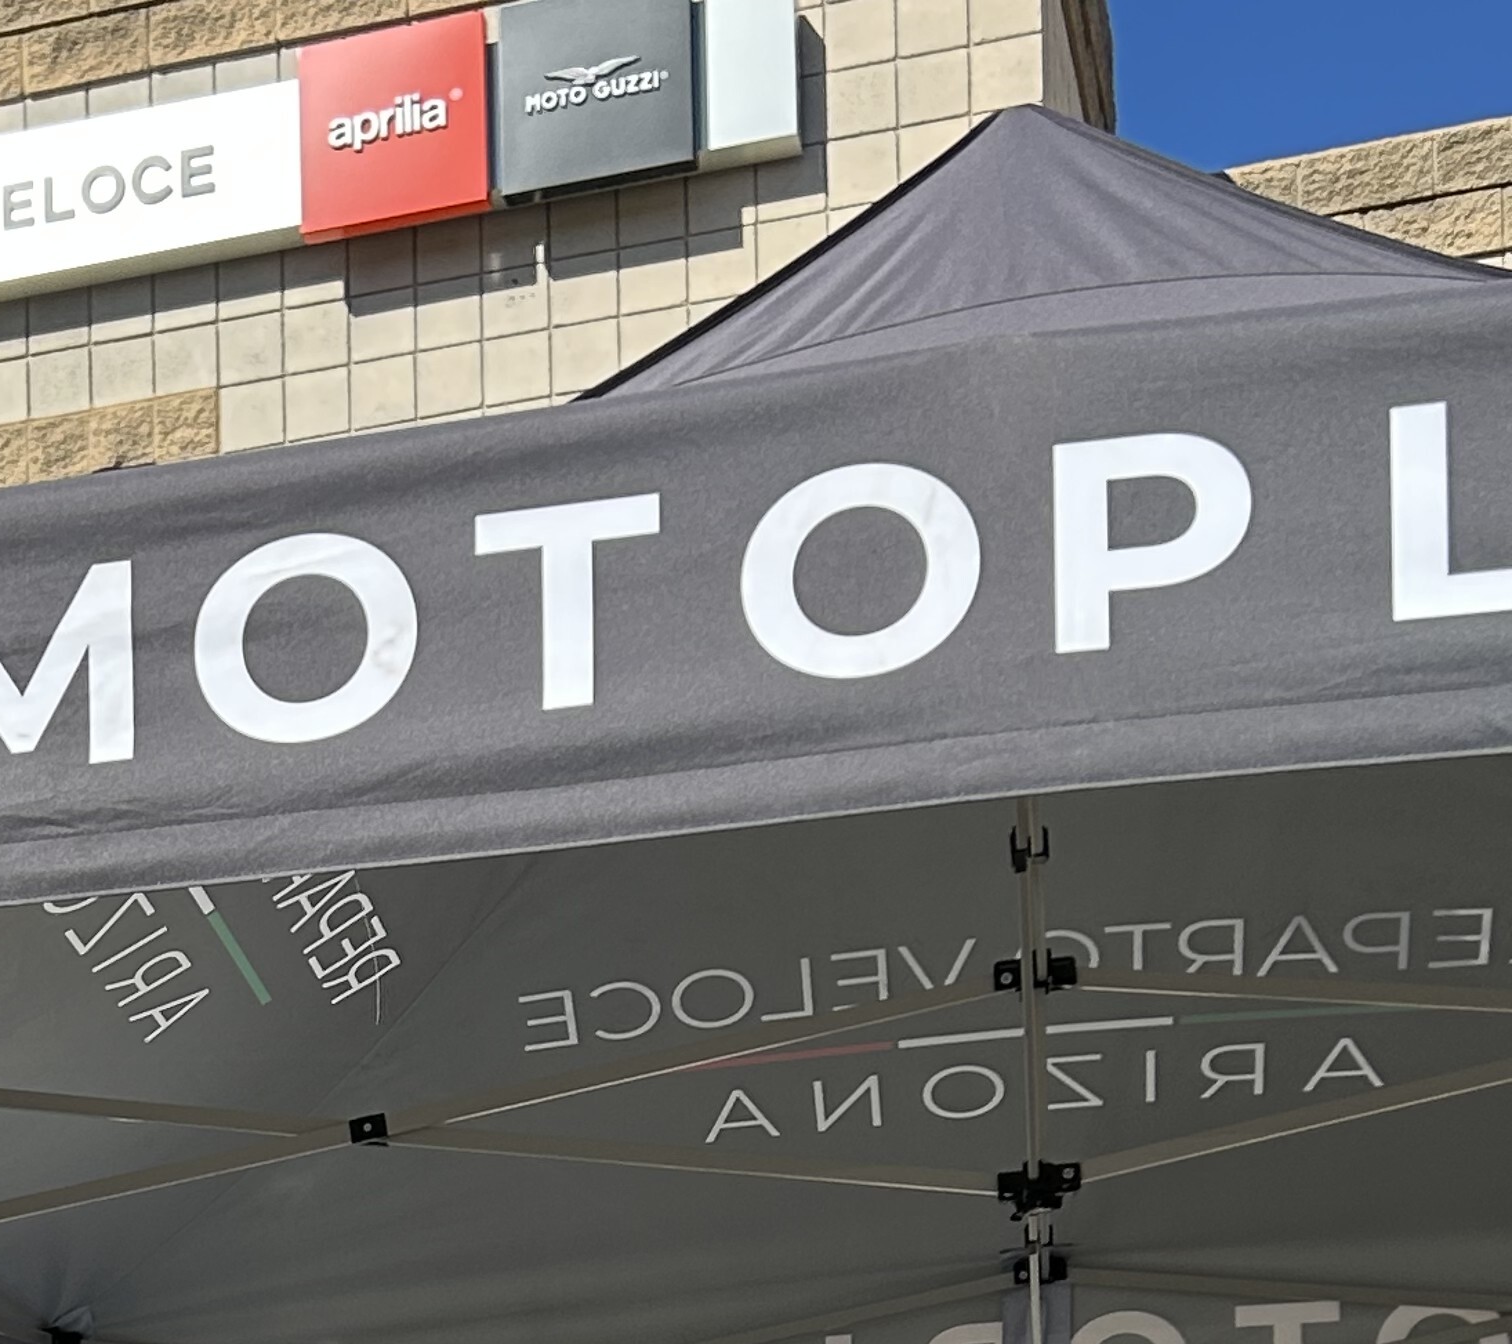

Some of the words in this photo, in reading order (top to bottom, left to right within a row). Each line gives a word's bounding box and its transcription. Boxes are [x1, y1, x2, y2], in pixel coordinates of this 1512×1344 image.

[524, 84, 587, 116] MOTO
[593, 70, 661, 100] GUZZI
[327, 91, 450, 154] aprilia
